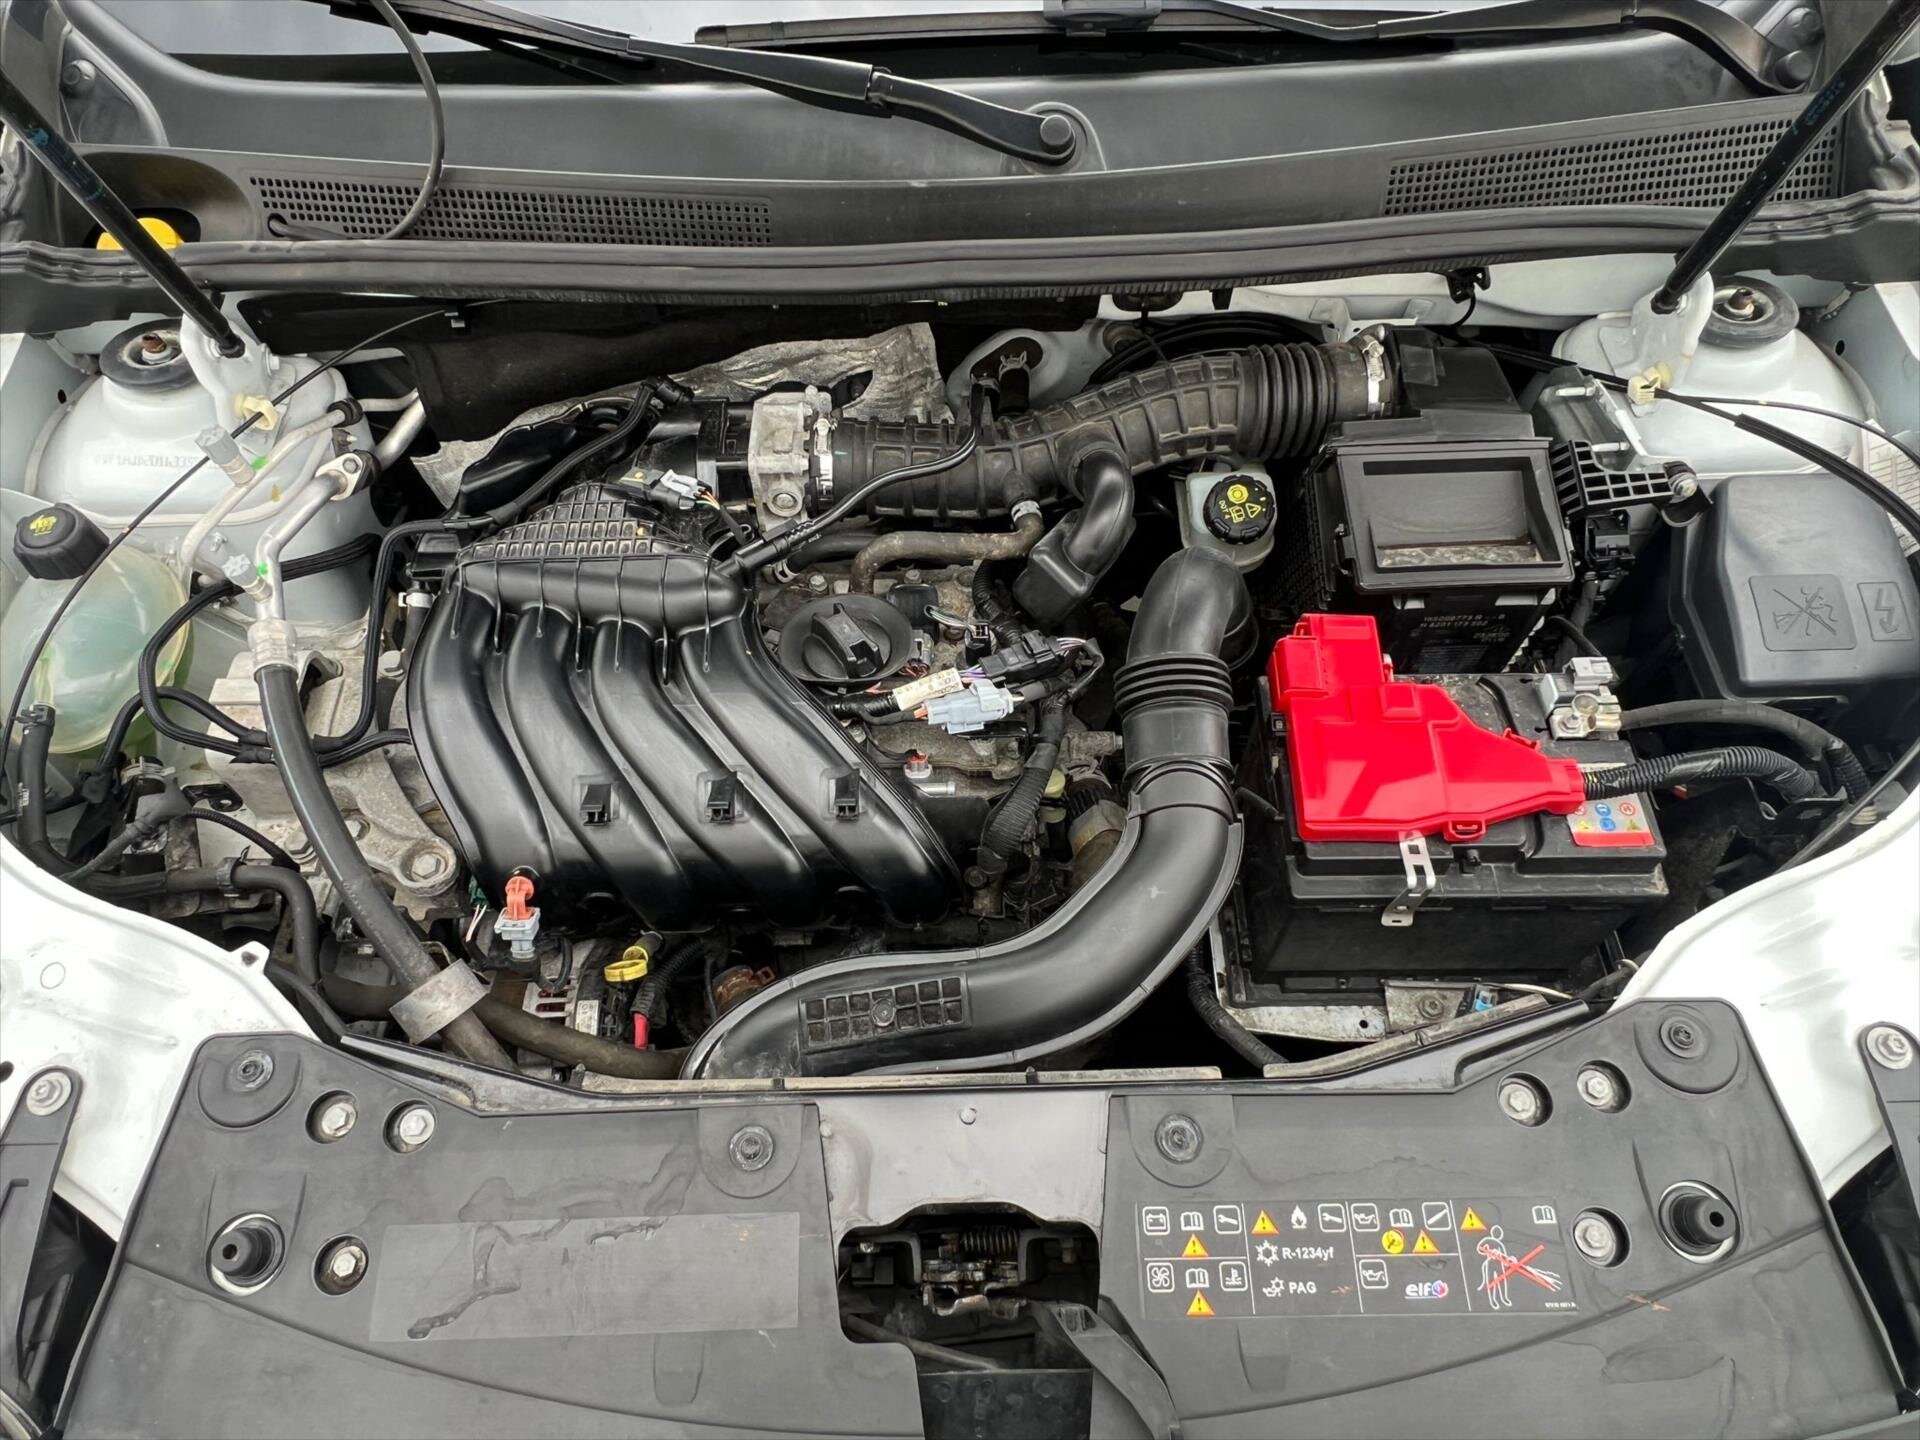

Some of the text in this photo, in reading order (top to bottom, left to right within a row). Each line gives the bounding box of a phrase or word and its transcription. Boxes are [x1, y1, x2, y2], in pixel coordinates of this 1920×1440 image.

[1282, 1246, 1334, 1261] R-1234yf
[1288, 1281, 1318, 1295] PAG
[1404, 1282, 1433, 1298] elf
